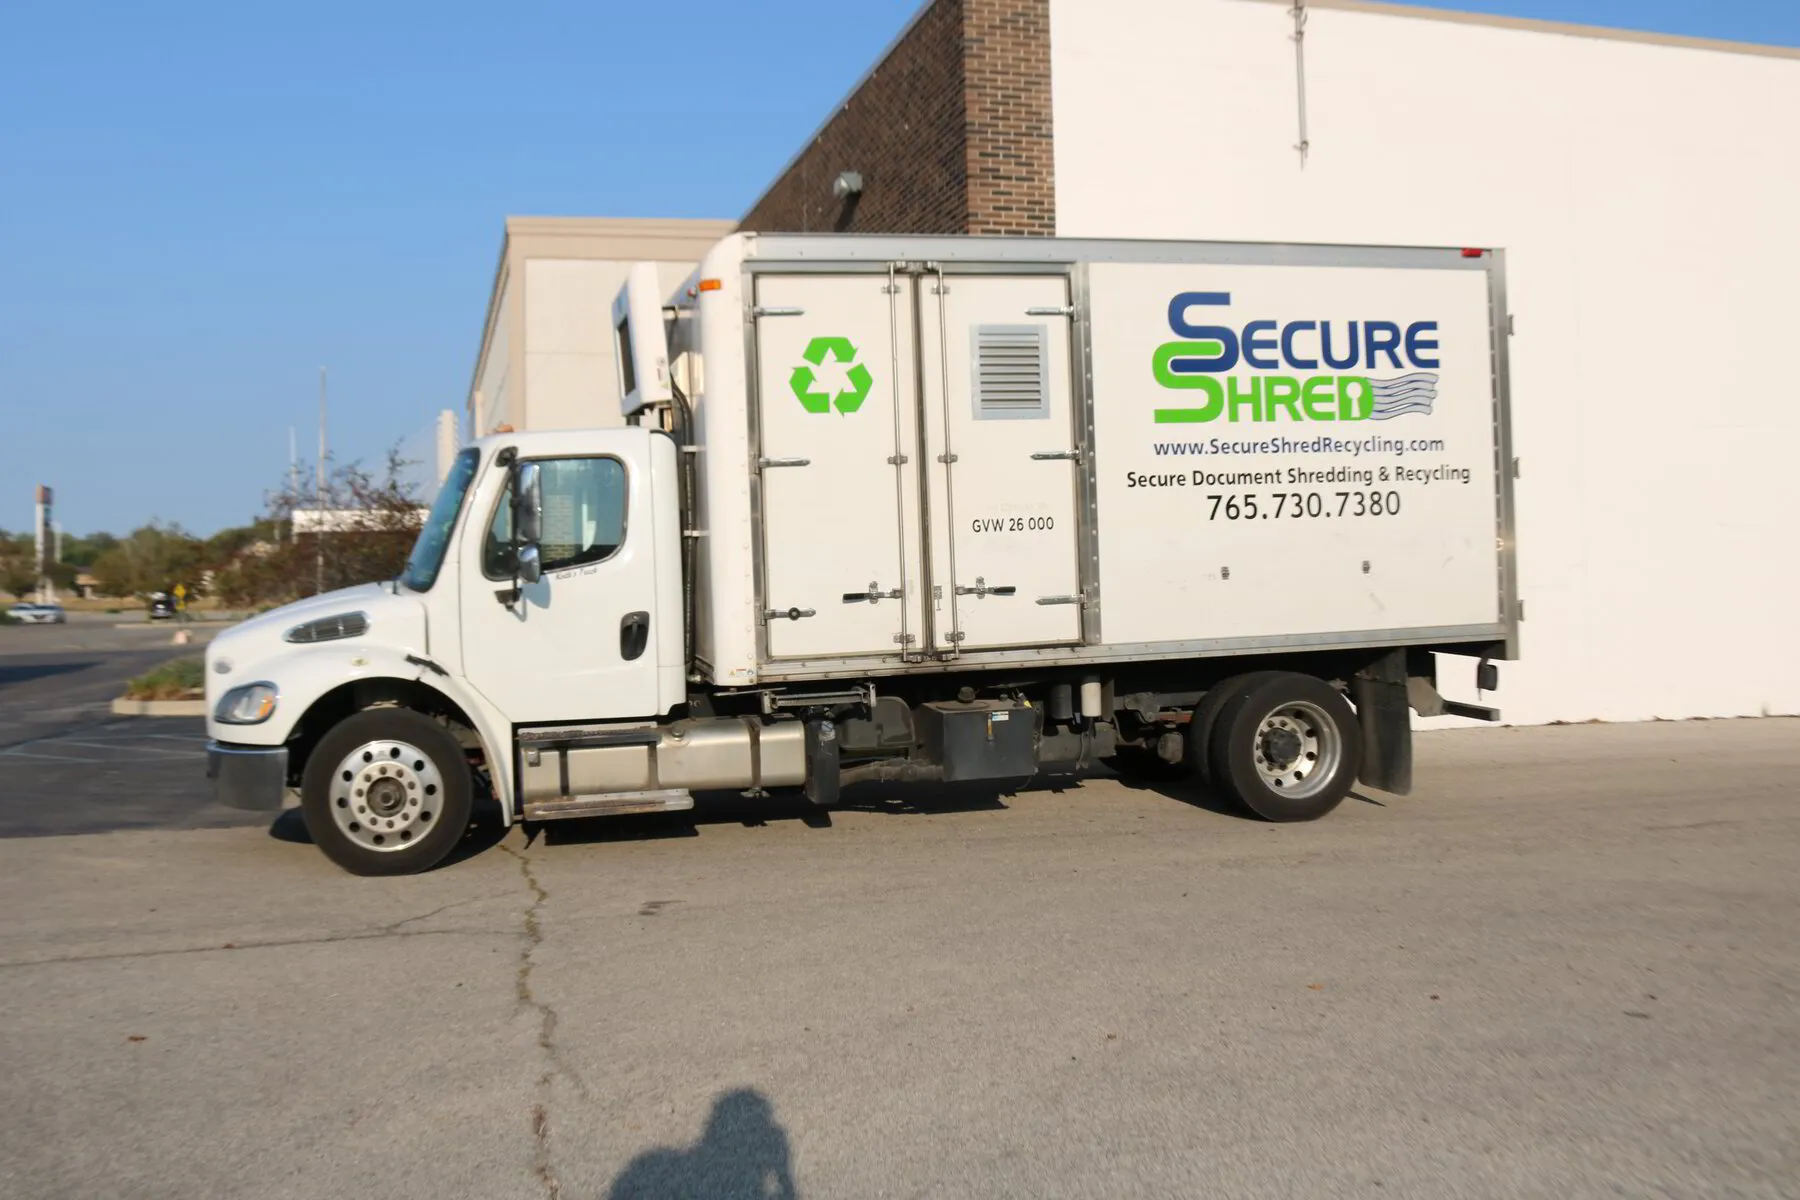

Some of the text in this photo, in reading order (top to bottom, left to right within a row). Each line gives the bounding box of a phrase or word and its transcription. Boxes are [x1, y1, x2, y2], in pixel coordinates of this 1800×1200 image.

[1168, 291, 1440, 373] SECURE
[1152, 341, 1375, 424] SHRED
[1153, 435, 1445, 456] www.SecureShredRecycling.com
[1127, 464, 1471, 488] Secure Document Shredding & Recycling
[1206, 490, 1401, 521] 765.730.7380
[972, 516, 1054, 533] GVW 26 000
